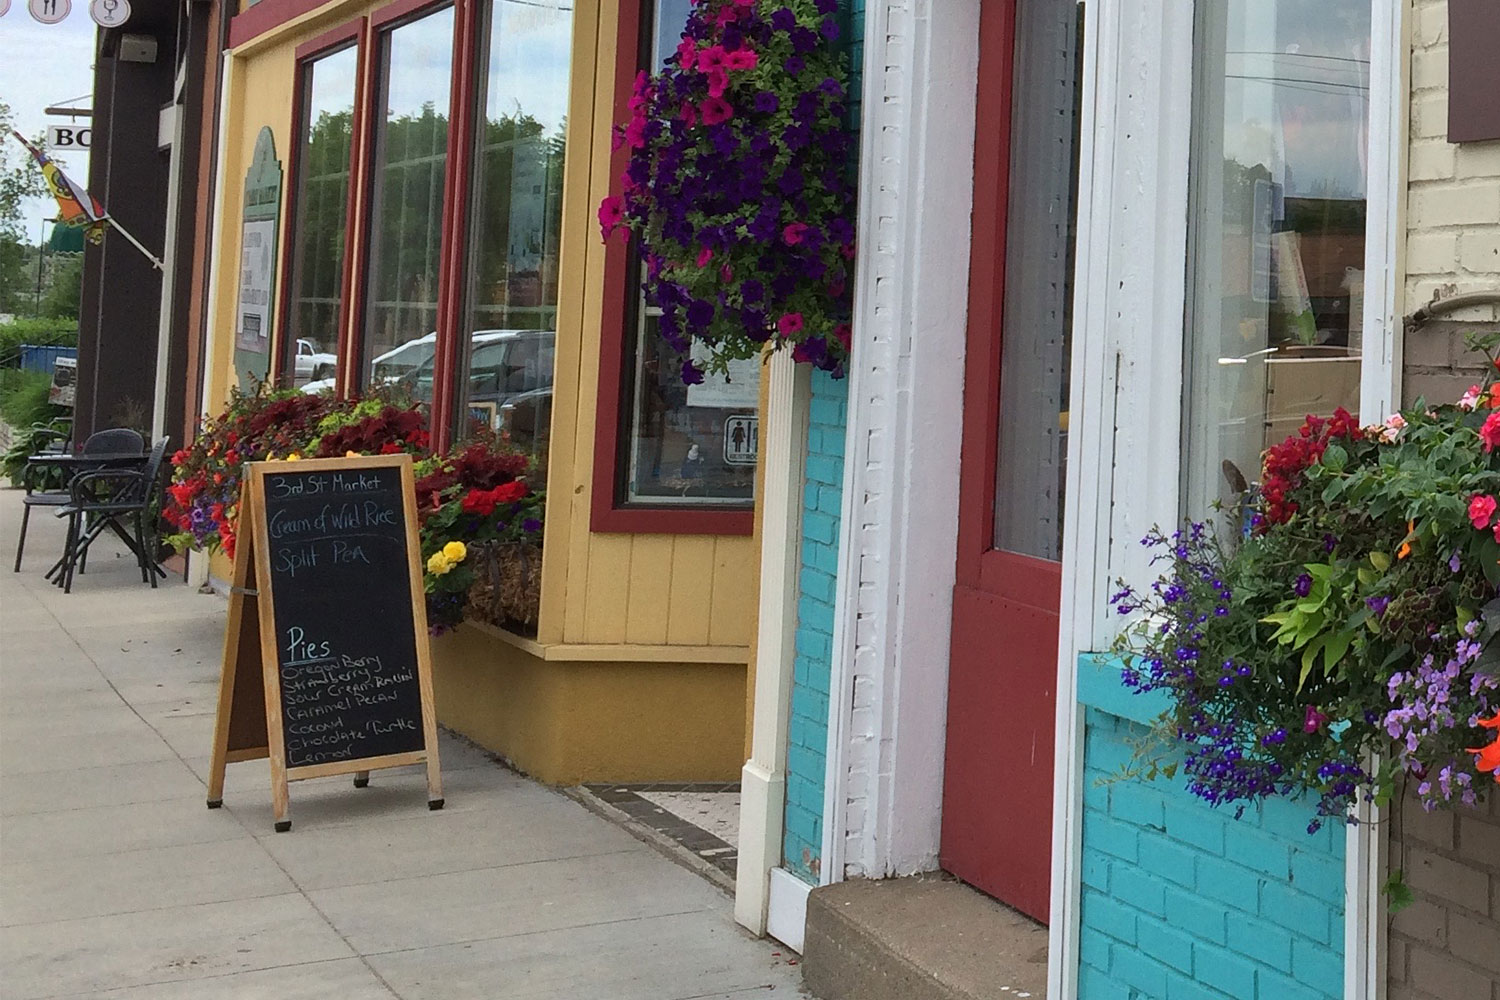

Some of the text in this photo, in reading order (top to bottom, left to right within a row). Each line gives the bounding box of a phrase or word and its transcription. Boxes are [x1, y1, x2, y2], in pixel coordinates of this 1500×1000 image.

[272, 473, 382, 499] 3rd St Market
[269, 509, 311, 539] Cream
[313, 504, 331, 533] of
[363, 500, 398, 527] Rice
[275, 544, 320, 578] Split
[286, 626, 331, 662] Pies
